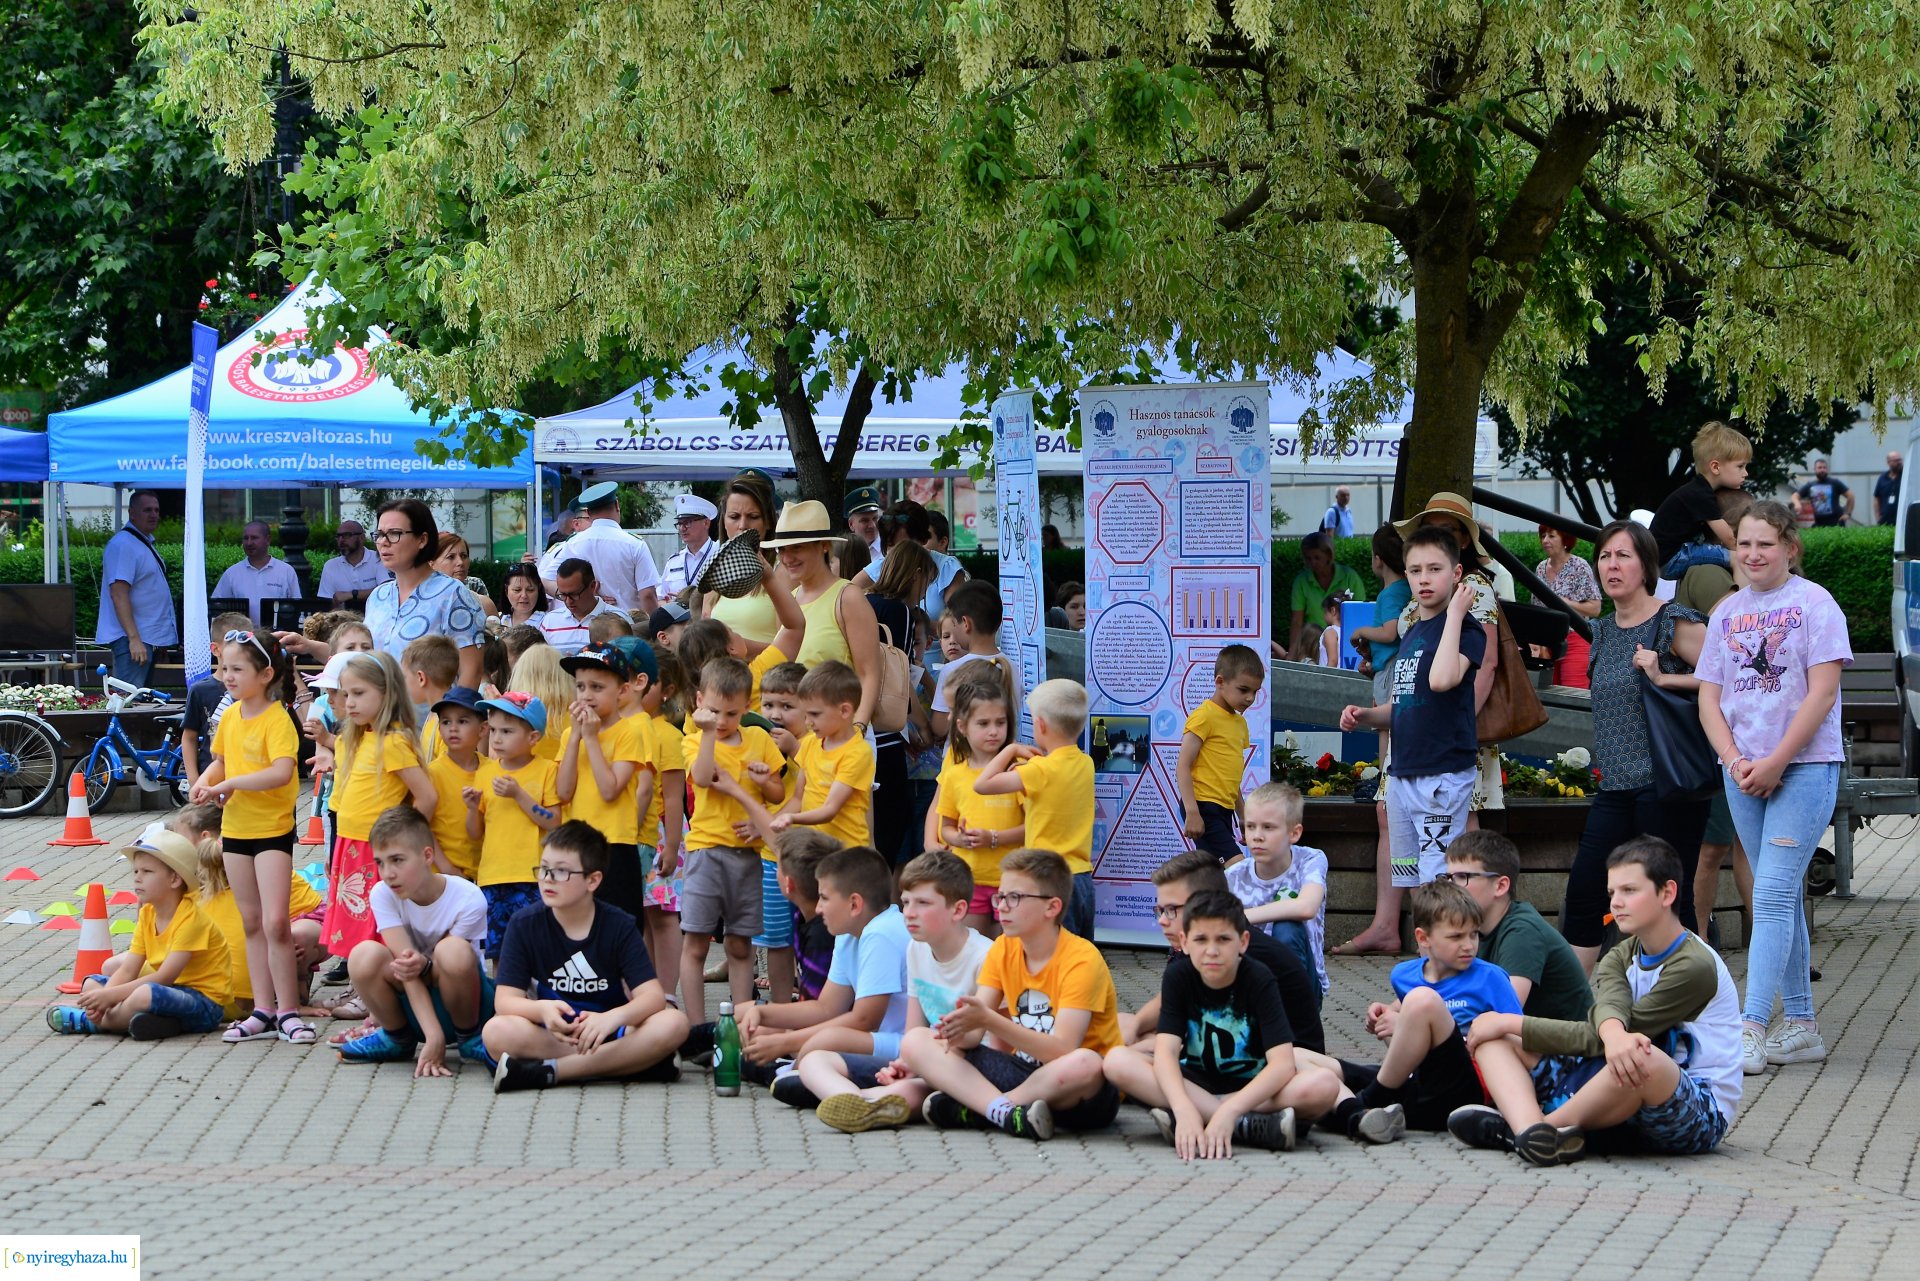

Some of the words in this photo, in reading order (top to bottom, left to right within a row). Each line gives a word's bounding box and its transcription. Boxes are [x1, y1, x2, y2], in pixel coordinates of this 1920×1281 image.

[1129, 408, 1171, 420] Hasznos
[1173, 407, 1216, 419] tanácsok
[207, 427, 392, 444] ww.kreszvaltozas.hu
[1136, 424, 1208, 440] gyalogosoknak
[1309, 438, 1400, 457] BIZOTTS
[117, 452, 467, 473] www.faebook.com/balesetmegeloes
[1722, 607, 1802, 639] RAMONES
[1395, 658, 1420, 672] BEACH
[548, 976, 609, 993] adidas
